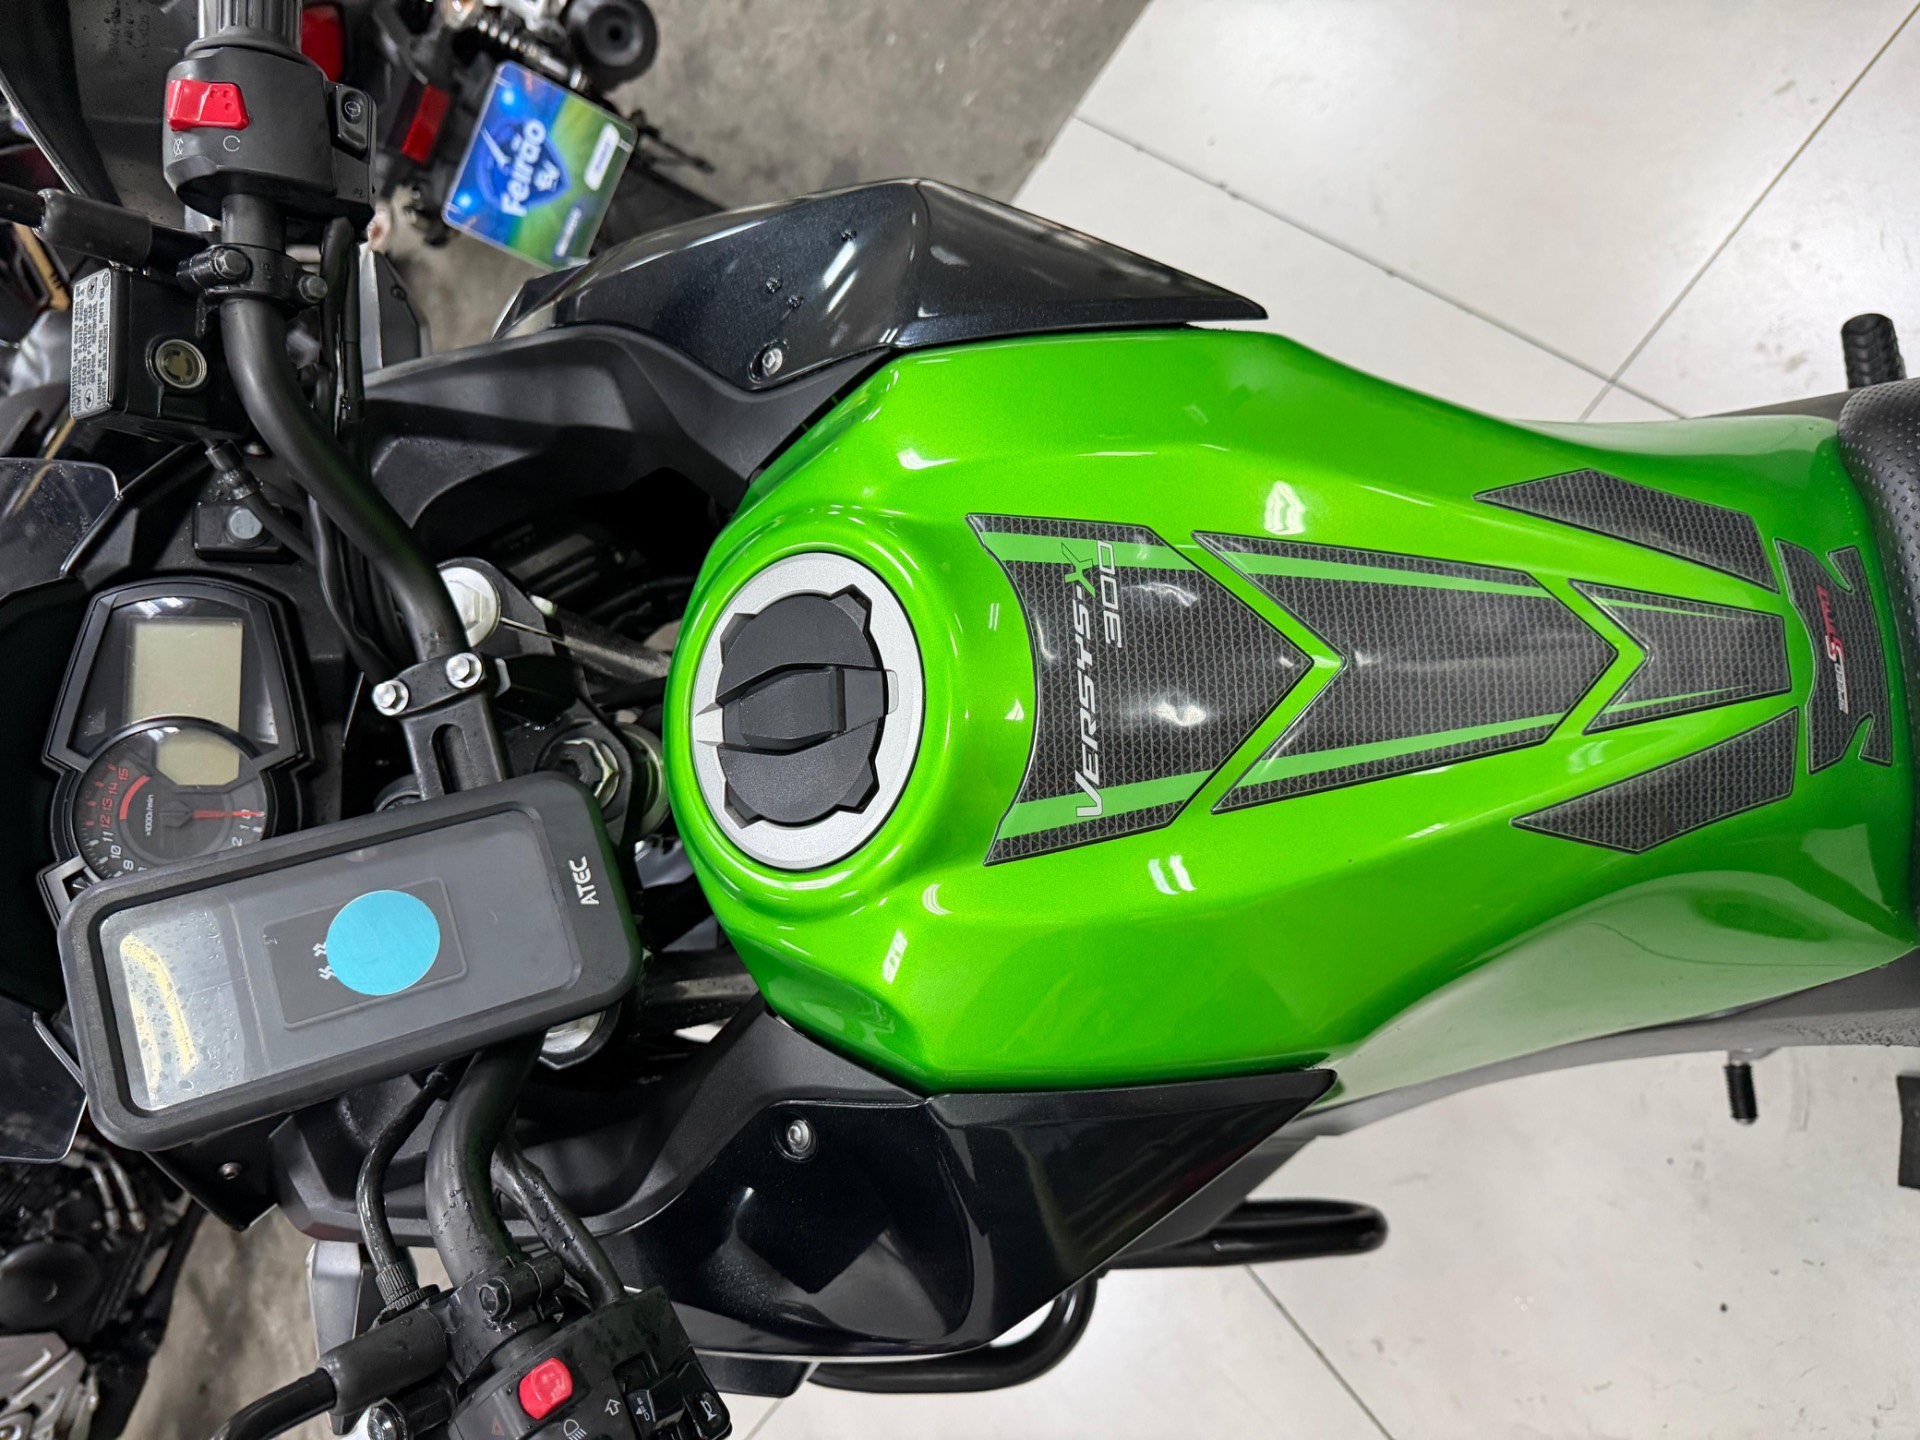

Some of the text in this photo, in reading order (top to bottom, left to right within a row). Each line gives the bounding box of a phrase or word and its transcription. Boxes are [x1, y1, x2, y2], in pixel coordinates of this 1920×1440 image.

[500, 119, 548, 217] Feirão
[1097, 540, 1123, 648] 300
[1060, 542, 1103, 819] VERSYS-X
[118, 767, 129, 781] 15
[108, 782, 119, 796] 14
[102, 798, 113, 812] 13
[100, 815, 112, 829] 12
[102, 831, 114, 842] 11
[232, 837, 243, 847] 2
[109, 845, 122, 860] 10
[568, 856, 600, 905] ATEC
